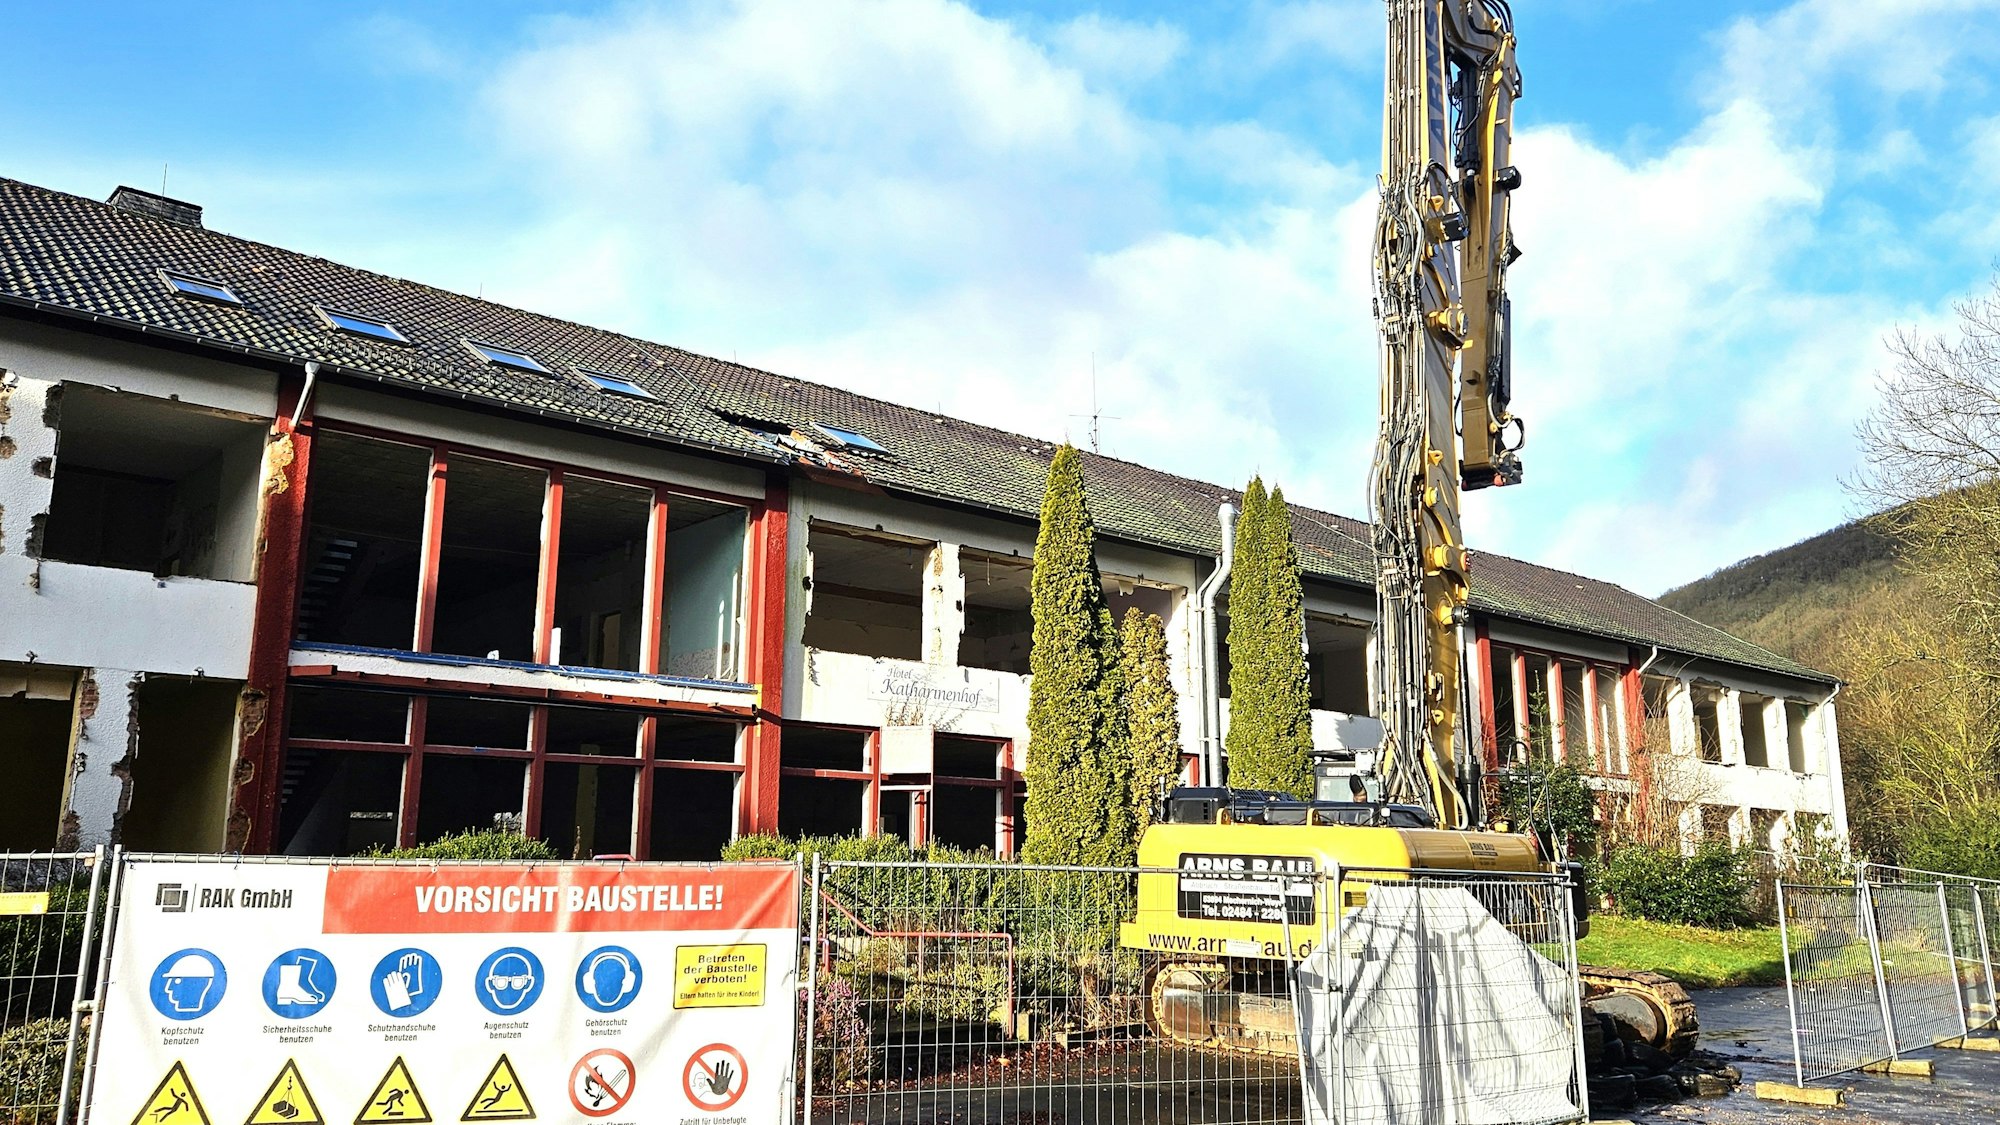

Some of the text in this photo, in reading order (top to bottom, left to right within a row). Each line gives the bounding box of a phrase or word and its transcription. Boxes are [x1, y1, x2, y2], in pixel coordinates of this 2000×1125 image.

[887, 666, 913, 680] Hotel
[1181, 857, 1305, 882] ARNS BAU
[200, 888, 293, 909] RAK GmbH
[415, 885, 724, 913] VORSICHT BAUSTELLE!
[1202, 904, 1220, 917] Tel.
[1221, 905, 1253, 918] 02484
[698, 953, 745, 963] Betreten
[684, 964, 758, 974] der Baustelle
[694, 974, 747, 984] verboten!
[367, 1024, 436, 1032] Schutzhandschuhe
[484, 1021, 529, 1031] Augenschutz
[585, 1019, 628, 1027] Gehörschutz
[161, 1026, 204, 1036] Kopfschutz
[262, 1025, 332, 1034] Sicherheitsschuhe
[590, 1028, 622, 1036] benutzen
[279, 1035, 314, 1043] benutzen
[384, 1034, 418, 1042] benutzen
[489, 1031, 522, 1039] benutzen
[163, 1037, 199, 1045] benutzen
[702, 1117, 711, 1125] für
[713, 1116, 747, 1125] Unbefugte
